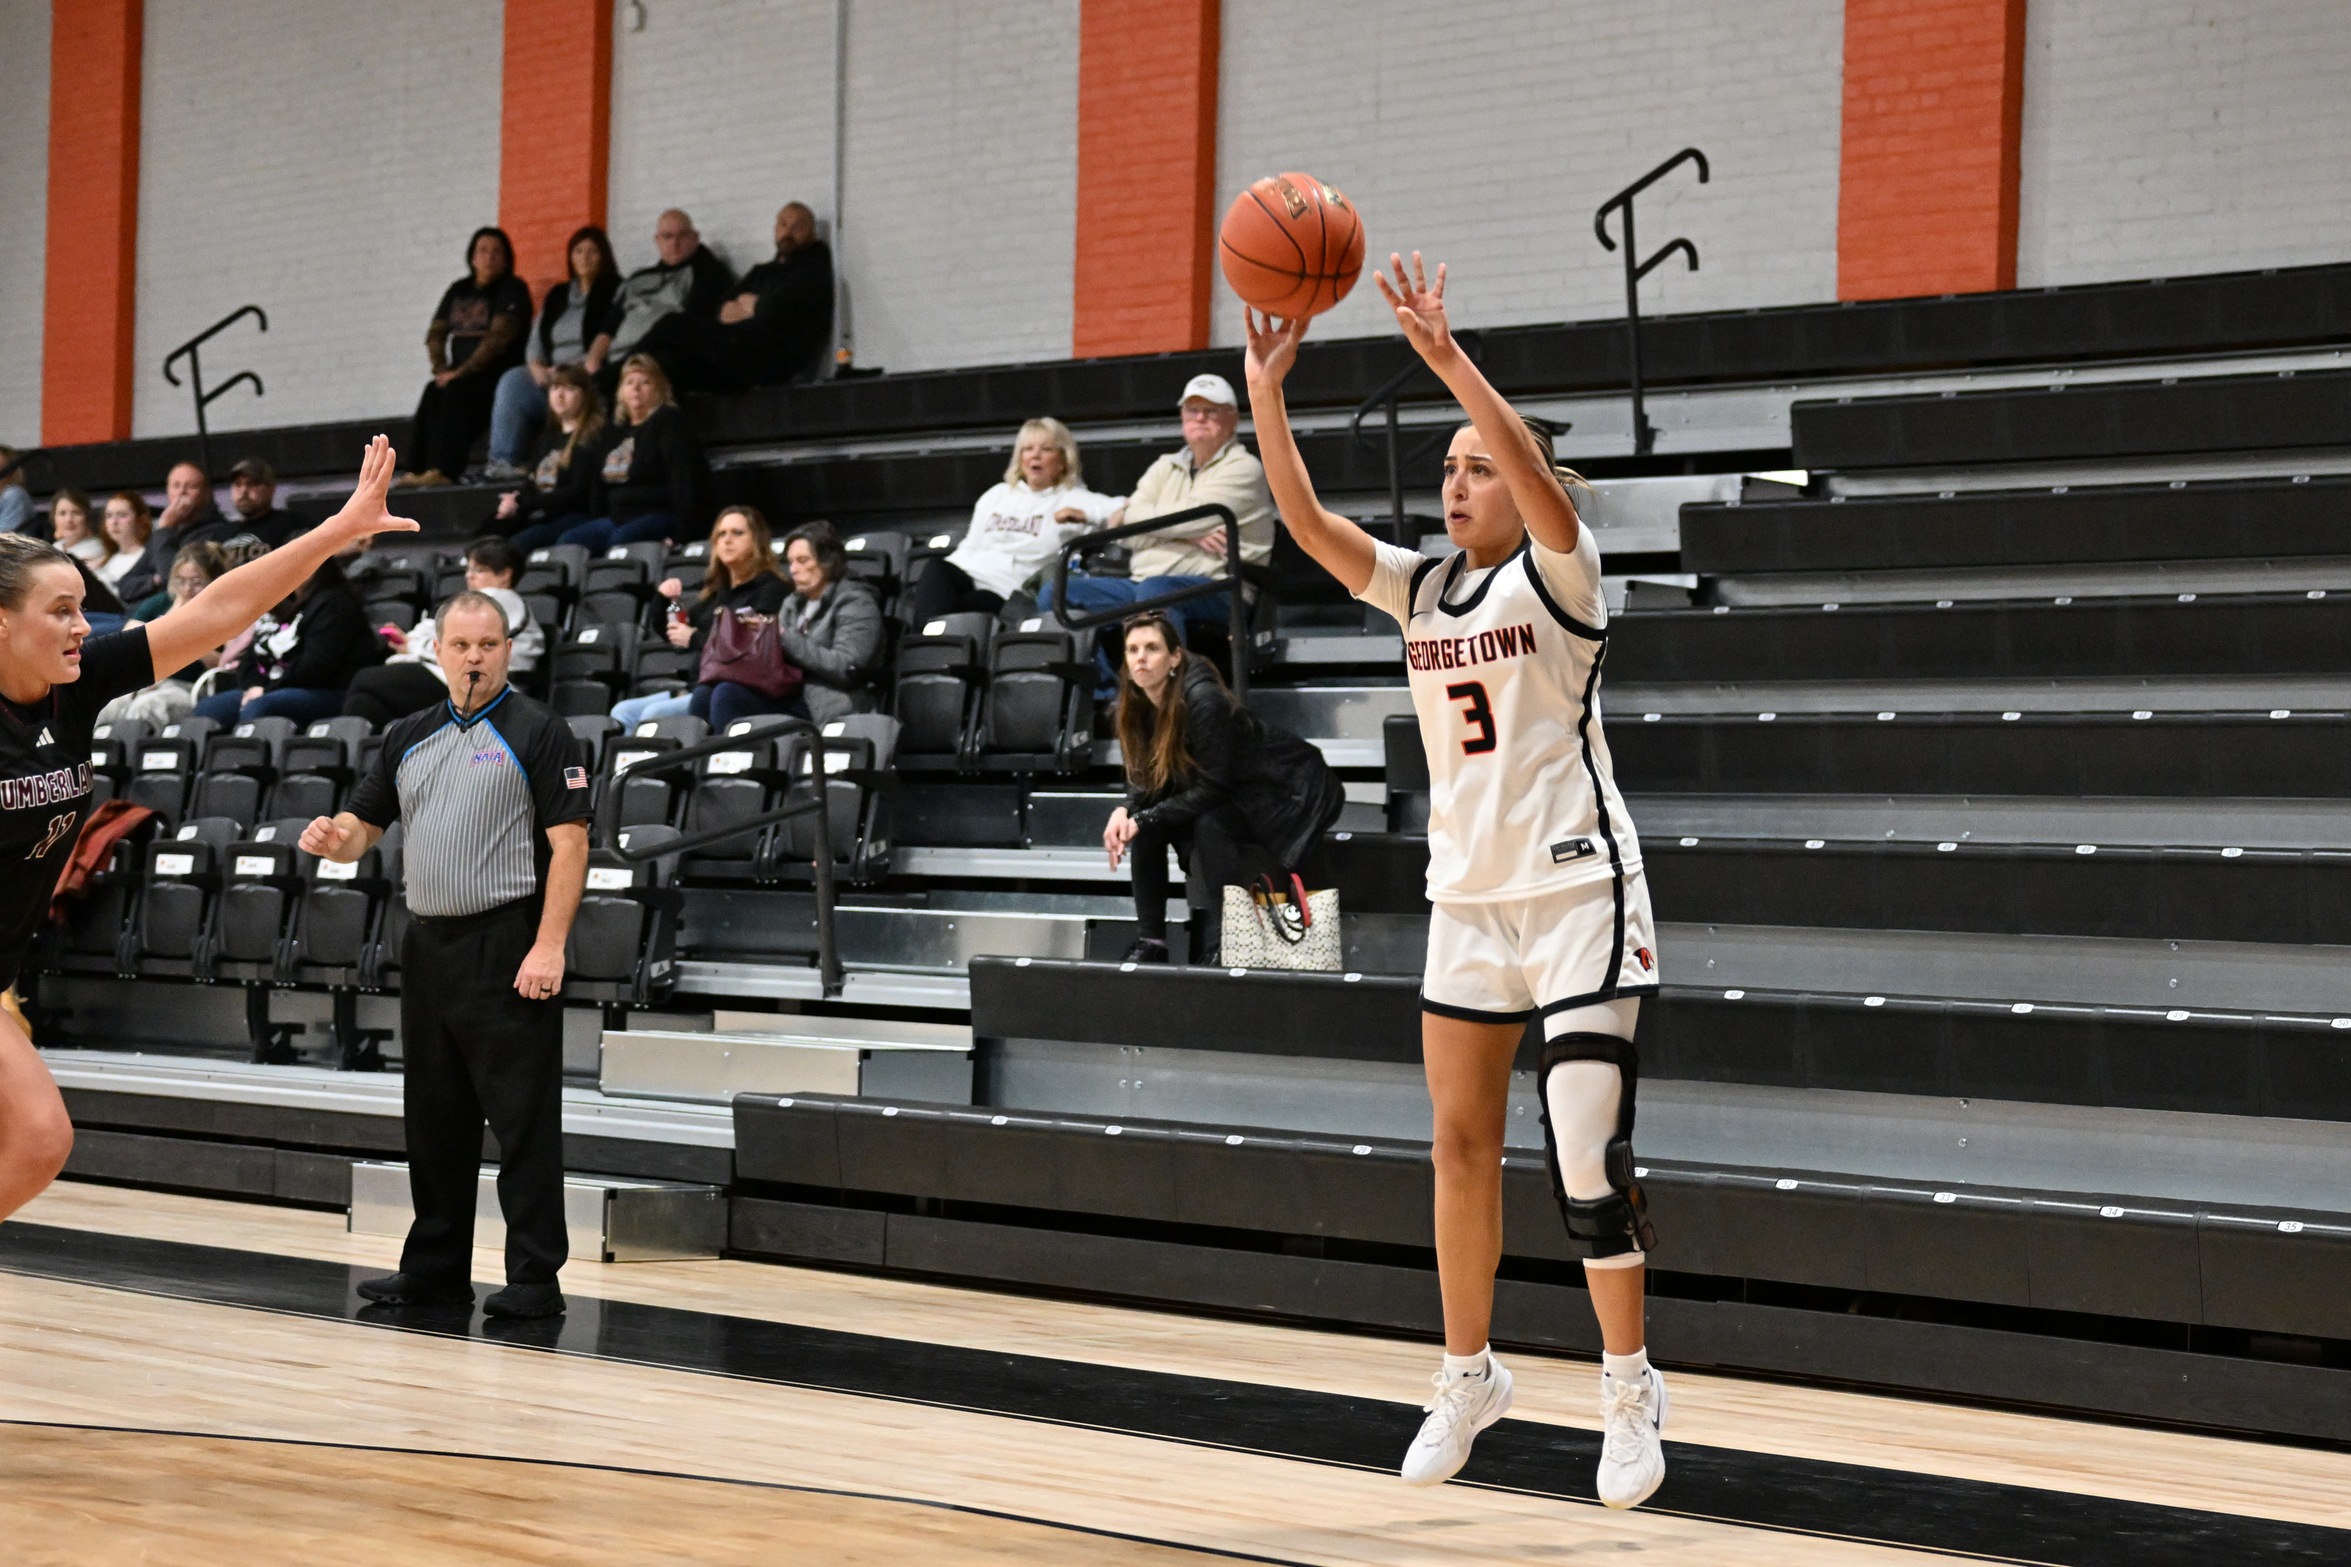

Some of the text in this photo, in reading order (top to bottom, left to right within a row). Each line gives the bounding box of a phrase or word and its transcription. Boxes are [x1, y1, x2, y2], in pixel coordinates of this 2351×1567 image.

[1408, 623, 1537, 671] GEORGETOWN
[1445, 680, 1497, 756] 3
[474, 752, 501, 763] NAIA
[2018, 1004, 2028, 1012] 48
[2172, 1011, 2184, 1019] 49
[2337, 1019, 2350, 1027] 50
[1781, 1180, 1793, 1188] 32
[1939, 1193, 1951, 1201] 33
[2105, 1208, 2118, 1216] 34
[2284, 1222, 2298, 1231] 35
